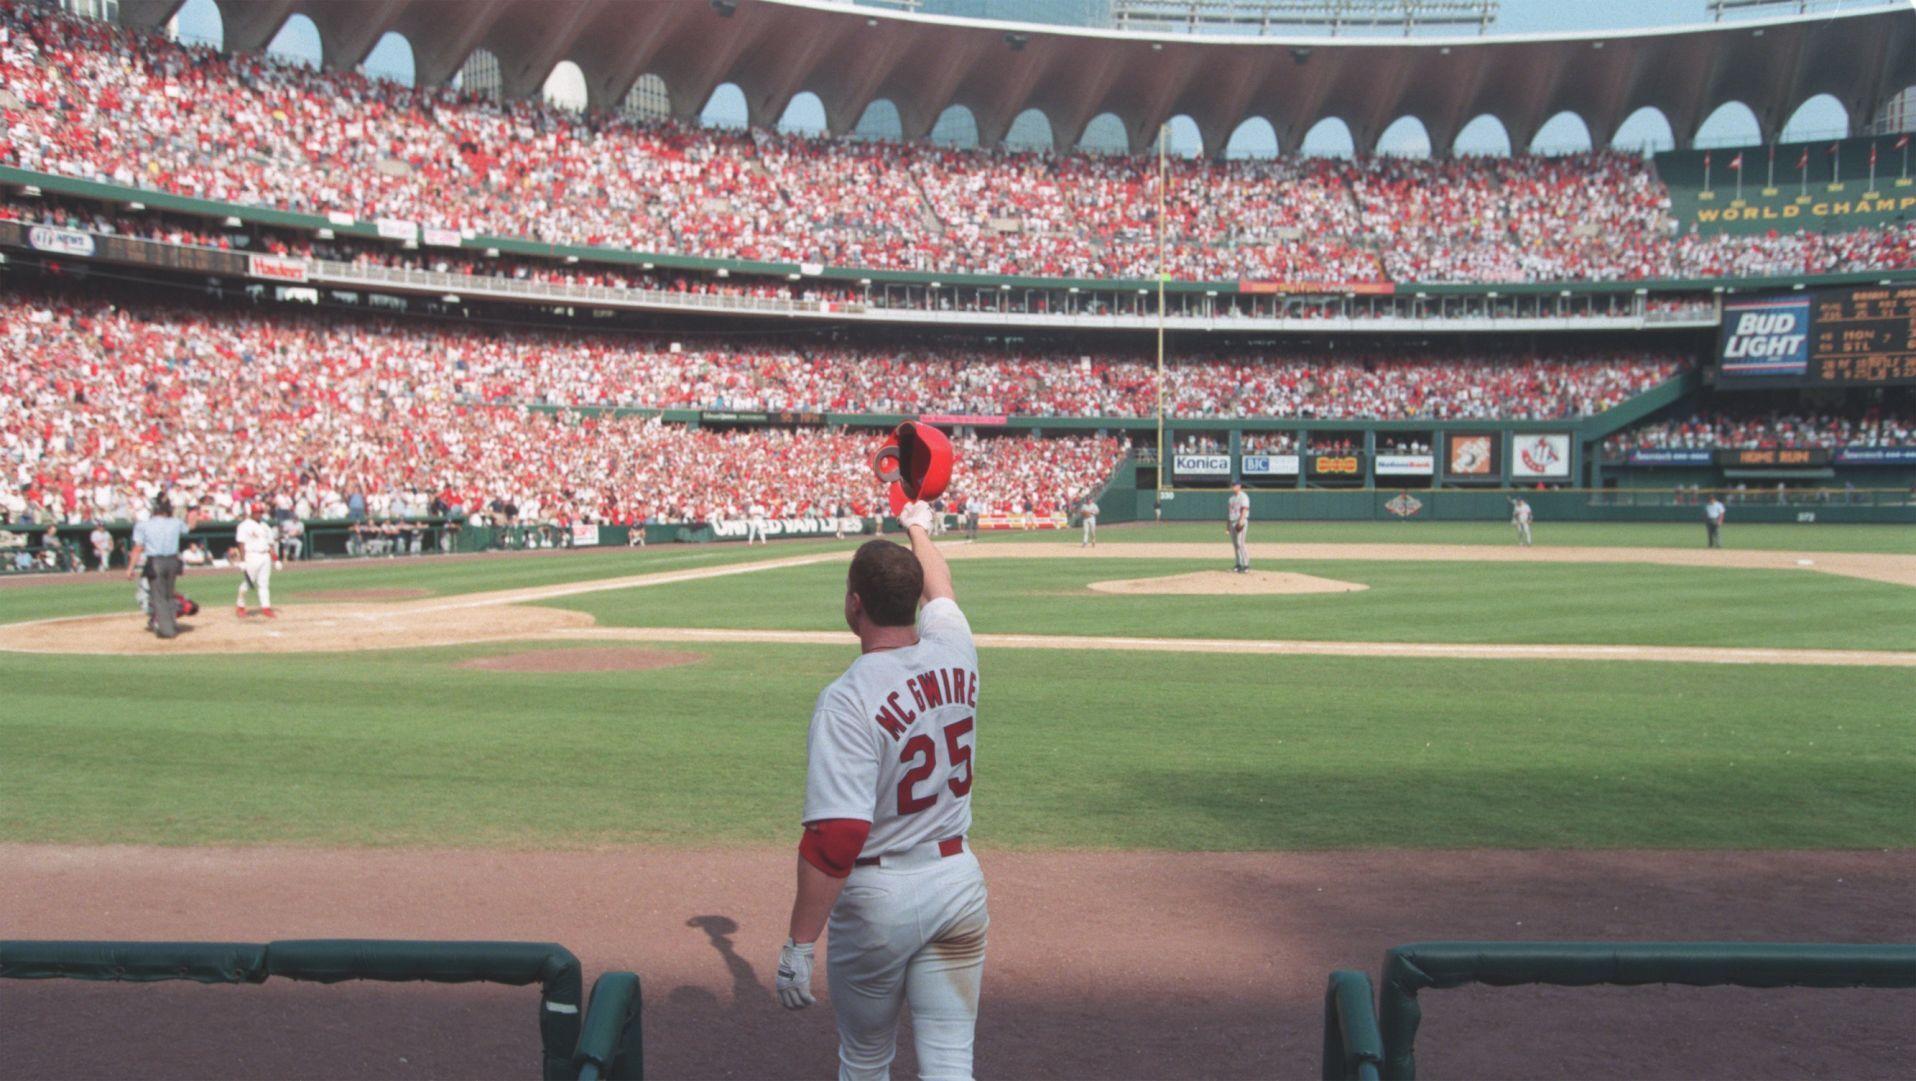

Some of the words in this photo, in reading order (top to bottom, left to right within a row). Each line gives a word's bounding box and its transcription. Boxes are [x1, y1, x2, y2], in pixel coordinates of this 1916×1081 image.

[1698, 205, 1800, 222] WORLD
[1812, 197, 1916, 216] CHAMP
[1736, 313, 1795, 335] BUD
[1723, 334, 1806, 358] LIGHT
[1176, 456, 1229, 470] Konica
[897, 715, 974, 816] 25
